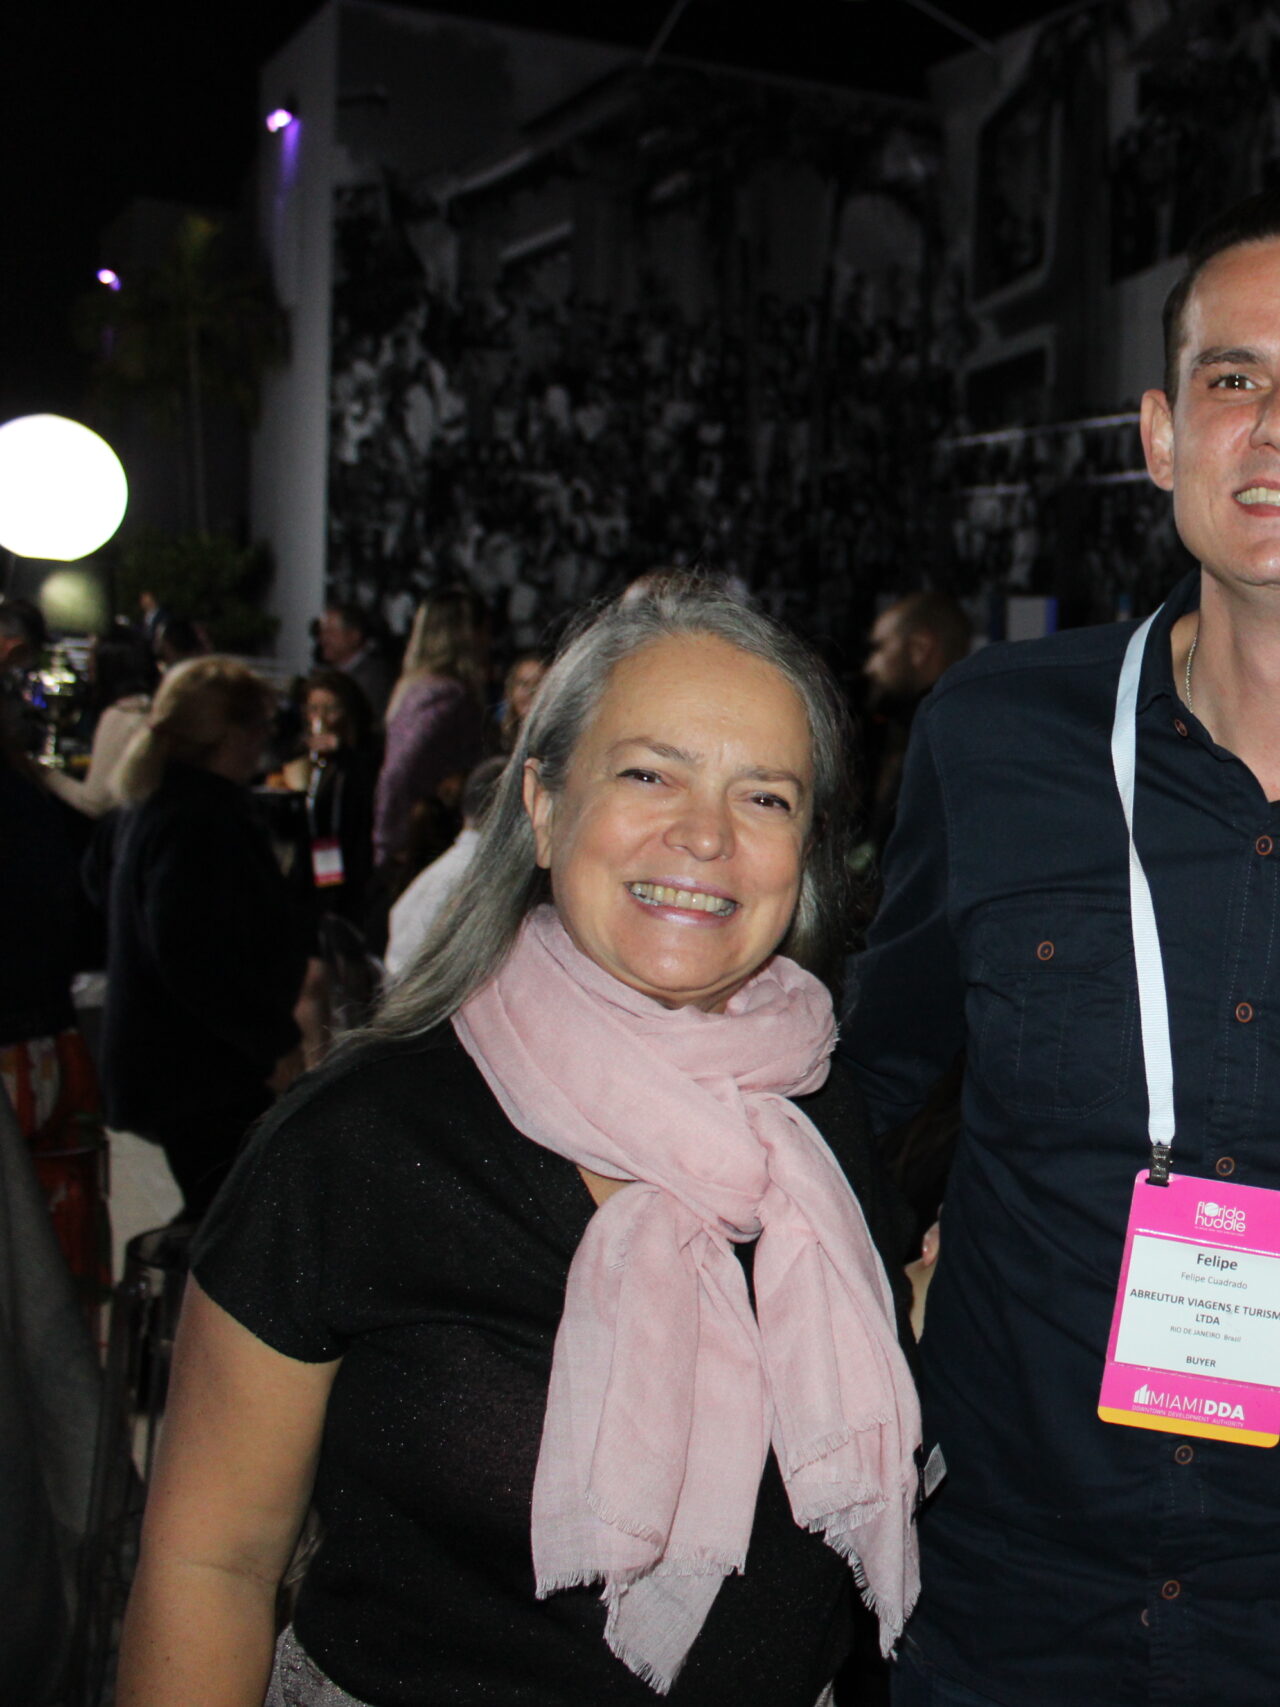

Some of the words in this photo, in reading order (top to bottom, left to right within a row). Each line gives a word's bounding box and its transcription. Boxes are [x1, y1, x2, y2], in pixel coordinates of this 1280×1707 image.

[1197, 1201, 1246, 1221] florida
[1195, 1213, 1246, 1232] huddle
[1196, 1253, 1238, 1271] Felipe
[1181, 1272, 1206, 1284] Felipe
[1208, 1276, 1248, 1290] Cuadrado
[1130, 1288, 1185, 1305] ABREUTUR
[1187, 1297, 1232, 1313] VIAGENS
[1234, 1305, 1240, 1314] E
[1195, 1314, 1220, 1326] LTDA
[1170, 1326, 1182, 1334] RIO
[1183, 1327, 1193, 1335] DE
[1186, 1356, 1217, 1368] BUYER
[1132, 1405, 1166, 1416] DOWNTOWN
[1168, 1410, 1210, 1423] DEVELOPMENT
[1212, 1418, 1244, 1428] AUTHORITY
